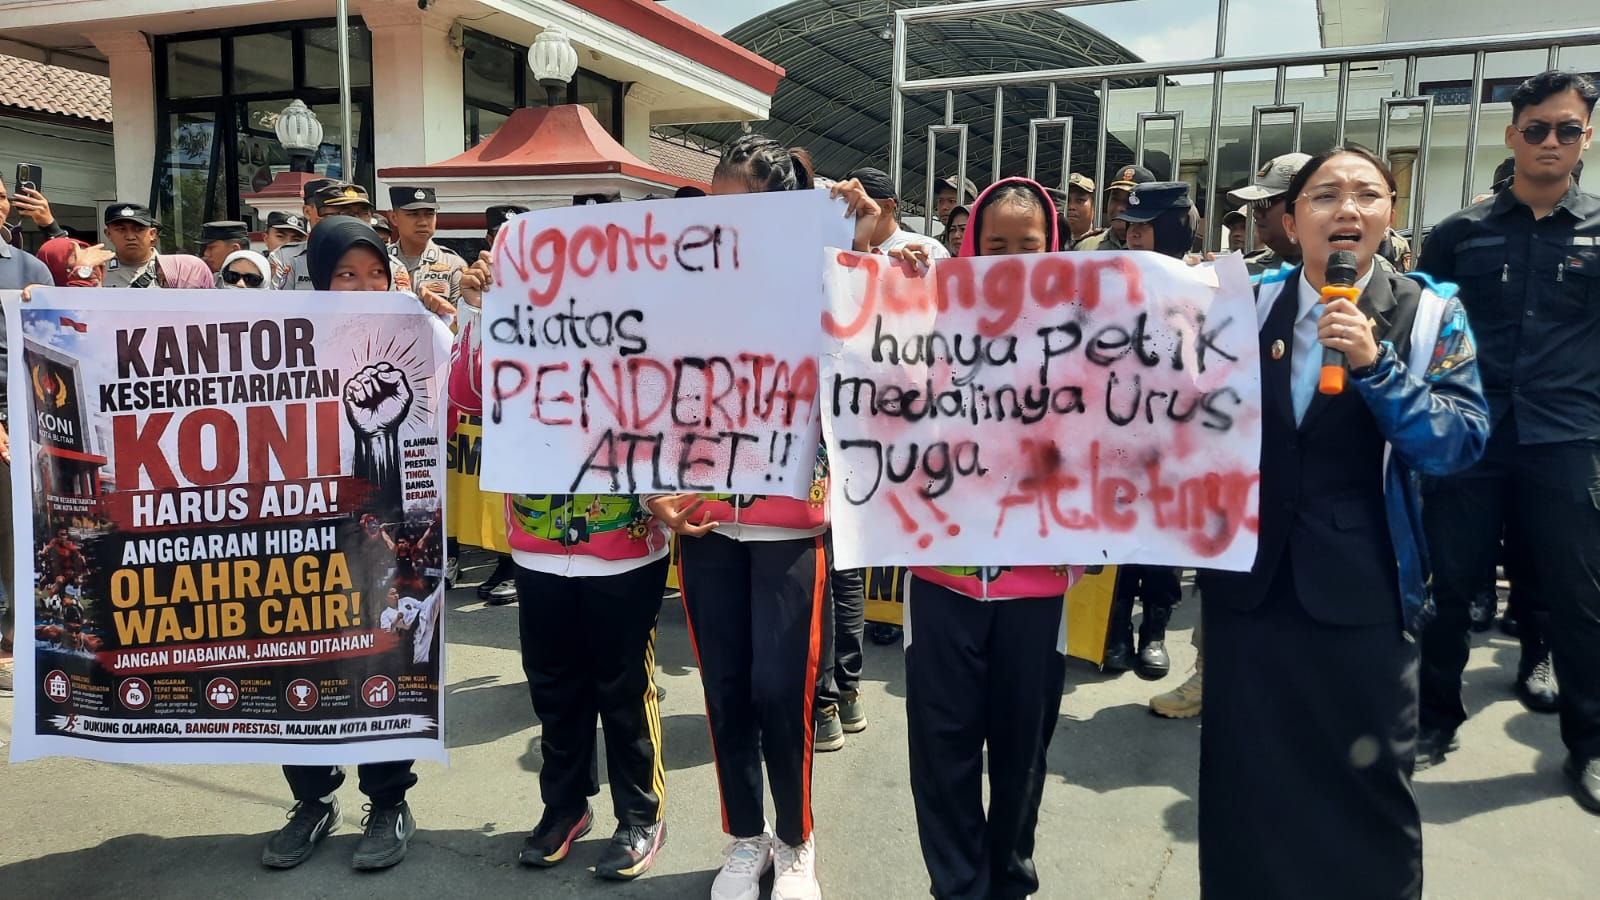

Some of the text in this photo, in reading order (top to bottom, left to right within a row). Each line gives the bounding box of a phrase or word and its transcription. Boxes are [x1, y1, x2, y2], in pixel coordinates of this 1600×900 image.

[491, 211, 740, 307] Ngonten
[820, 252, 1145, 339] Jangan
[489, 297, 647, 356] diatas
[116, 318, 316, 379] KANTOR
[872, 315, 1018, 386] hanya
[100, 369, 339, 412] KESEKRETARIATAN
[37, 409, 73, 436] KONI
[403, 437, 438, 447] OLAHRAGA
[113, 401, 341, 491] KONI
[404, 449, 426, 458] MAJU,
[404, 459, 436, 469] PRESTASI
[570, 429, 759, 494] ATLET
[132, 481, 338, 528] HARUS ADA!
[406, 480, 434, 490] BANGSA
[406, 490, 437, 500] BERJAYA!
[121, 526, 336, 566] ANGGARAN HIBAH
[110, 552, 352, 608] OLAHRAGA
[113, 591, 361, 646] WAJIB CAIR!
[114, 634, 374, 669] JANGAN DIABAIKAN, JANGAN DITAHAN!
[130, 693, 140, 702] Rp
[83, 718, 411, 736] DUKUNG OLAHRAGA, BANGUN PRESTASI, MAJUKAN KOTA BLITAR!
